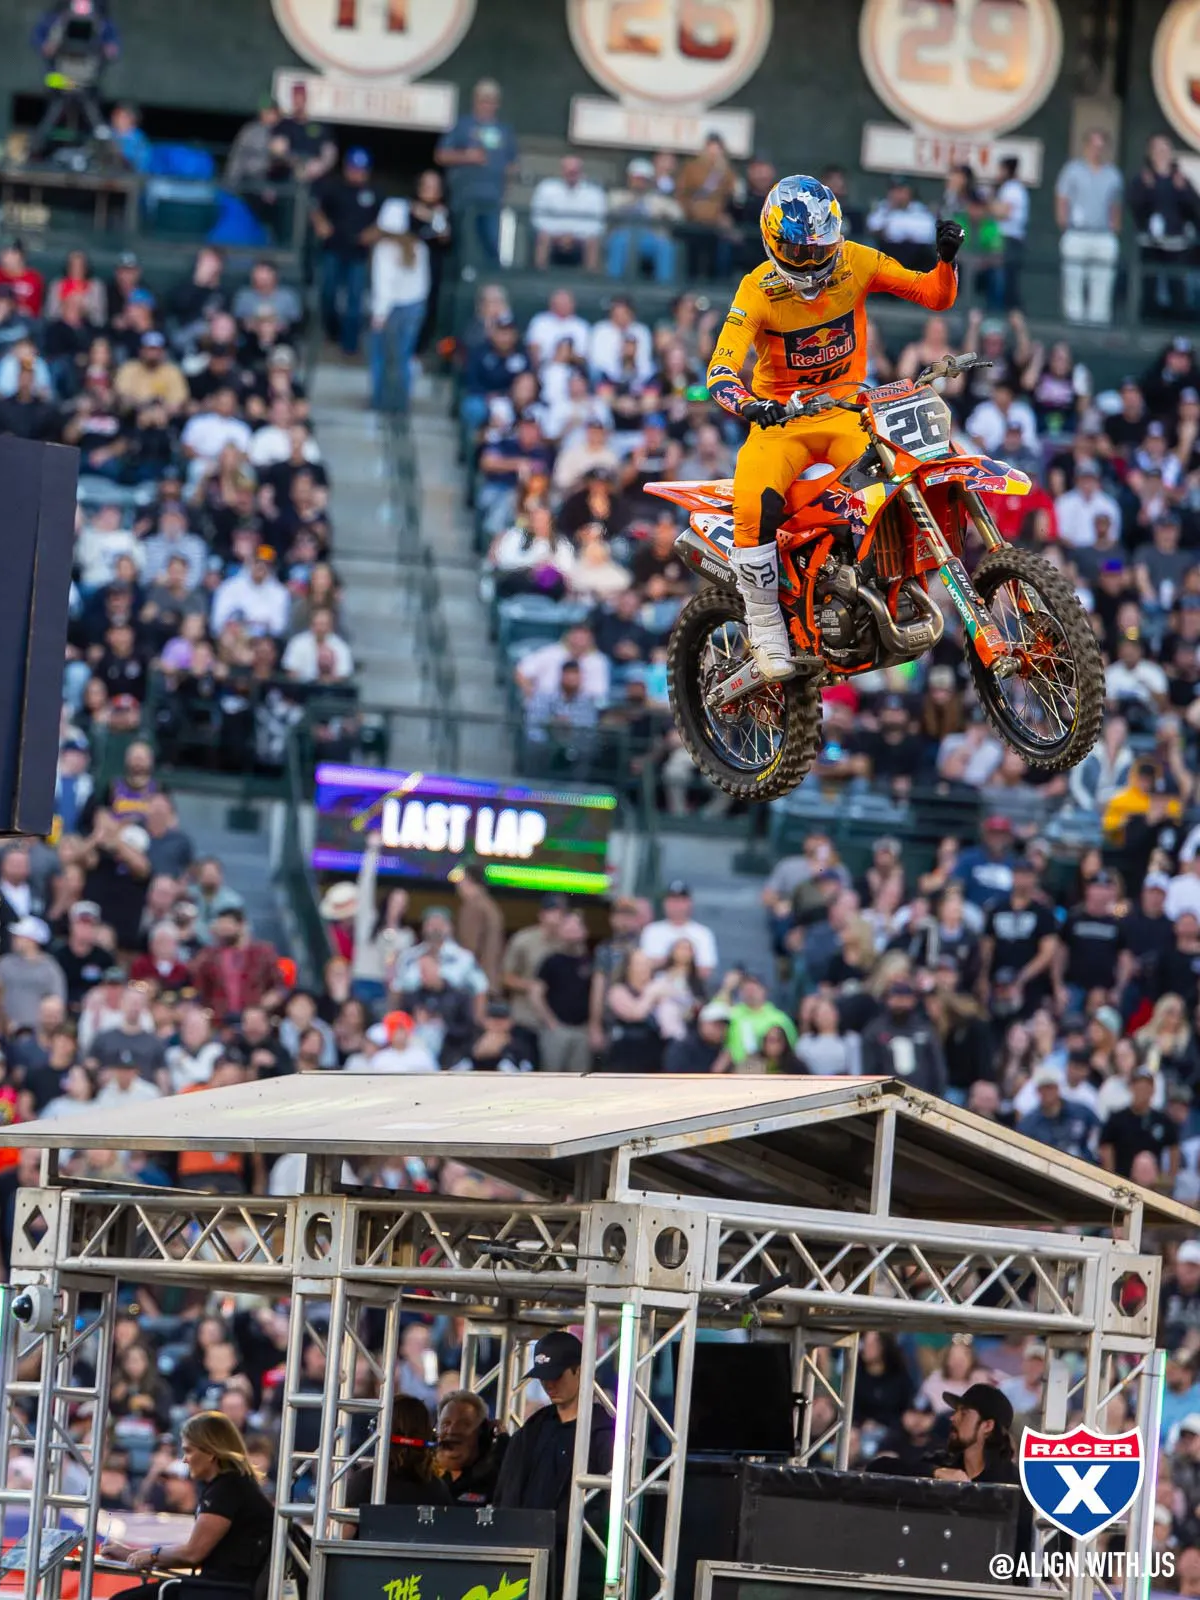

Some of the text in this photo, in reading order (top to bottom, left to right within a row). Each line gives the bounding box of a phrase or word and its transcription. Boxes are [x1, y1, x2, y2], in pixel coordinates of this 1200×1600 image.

[896, 0, 1032, 93] 29
[789, 336, 853, 367] Red Bull
[798, 360, 851, 385] KTM
[885, 400, 951, 447] 26
[946, 583, 974, 625] MOTOREX
[381, 798, 547, 859] LAST LAP
[383, 1574, 423, 1600] THE
